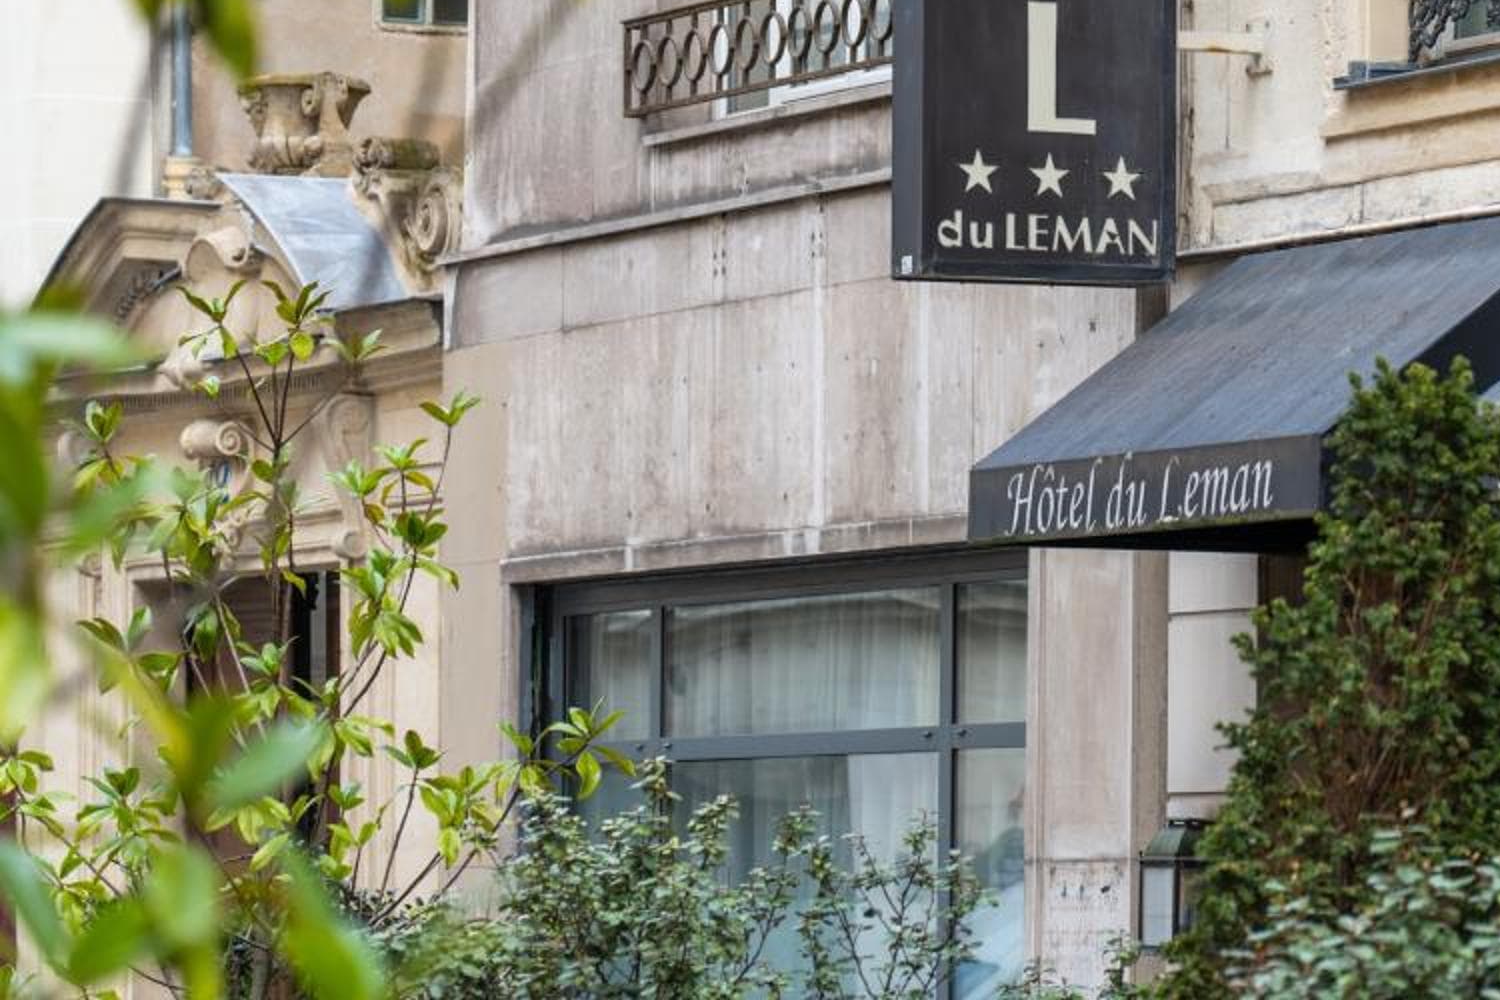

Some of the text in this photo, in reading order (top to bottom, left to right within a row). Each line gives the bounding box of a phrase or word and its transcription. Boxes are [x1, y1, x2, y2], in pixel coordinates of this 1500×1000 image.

[936, 209, 1159, 257] du LEMAN
[1003, 451, 1275, 537] Hôtel du Leman
